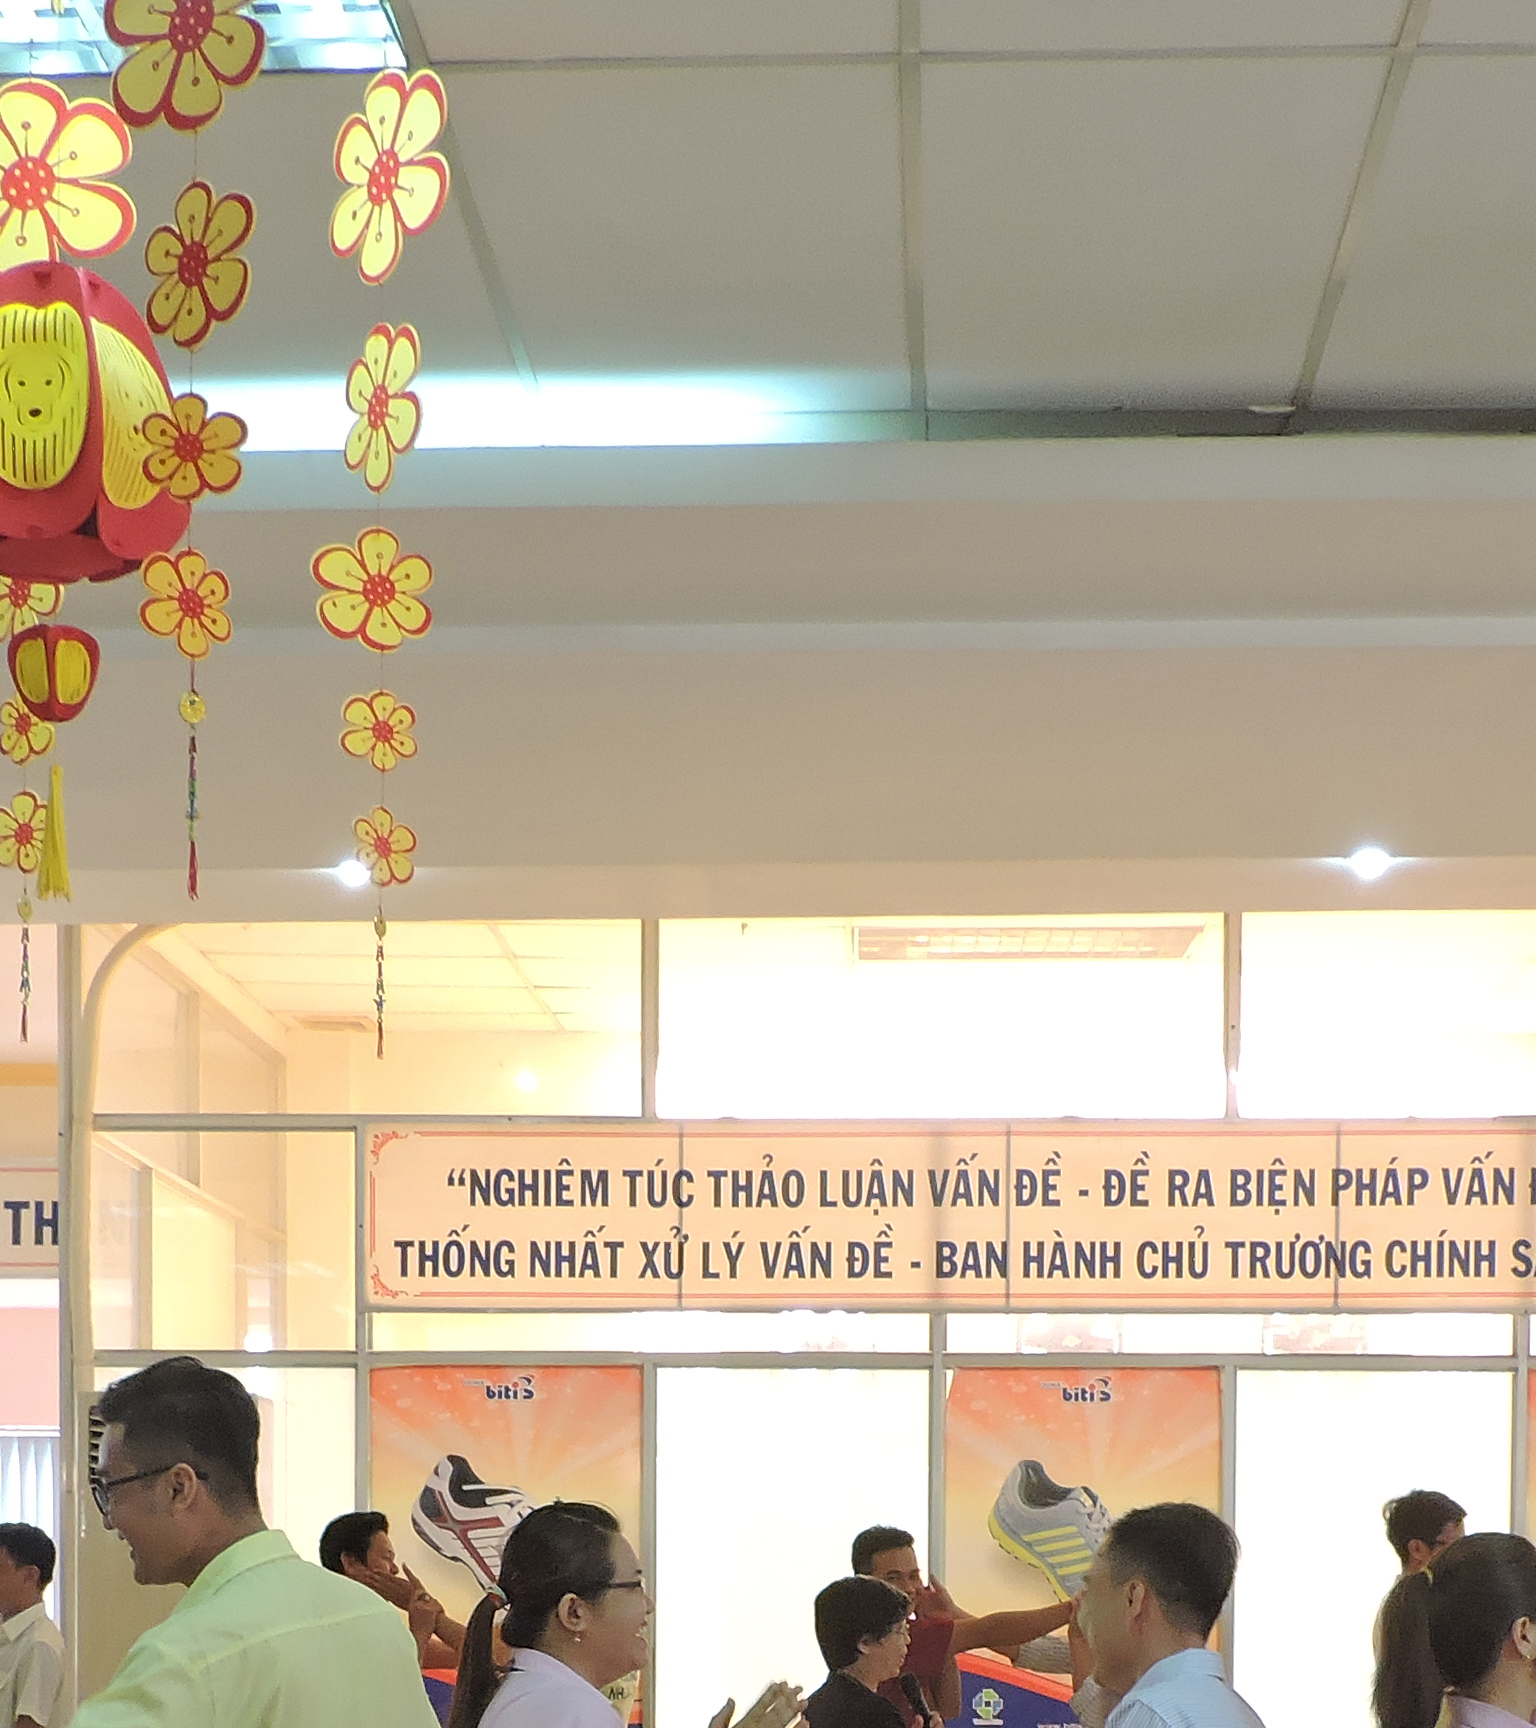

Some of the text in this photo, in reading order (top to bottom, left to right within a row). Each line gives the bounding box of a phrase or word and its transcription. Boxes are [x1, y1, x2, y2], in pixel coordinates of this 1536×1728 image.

[447, 1157, 610, 1208] “NGHIÊM
[621, 1158, 696, 1209] TÚC
[706, 1153, 806, 1208] THẢO
[818, 1158, 915, 1216] LUẬN
[927, 1152, 1001, 1208] VẤN
[1013, 1150, 1063, 1207] ĐỀ
[1101, 1150, 1151, 1207] ĐỀ
[1167, 1168, 1216, 1207] RA
[1229, 1158, 1317, 1216] BIỆN
[1330, 1156, 1430, 1207] PHÁP
[1440, 1150, 1516, 1207] VẤN
[4, 1199, 60, 1247] TH
[393, 1223, 516, 1279] THỐNG
[529, 1224, 625, 1279] NHẤT
[638, 1224, 690, 1280] XỬ
[701, 1230, 746, 1280] LÝ
[759, 1224, 833, 1280] VẤN
[845, 1222, 894, 1279] ĐỀ
[935, 1240, 1008, 1280] BAN
[1021, 1229, 1122, 1279] HÀNH
[1136, 1224, 1210, 1280] CHỦ
[1224, 1231, 1373, 1280] TRƯƠNG
[1384, 1228, 1497, 1279] CHÍNH
